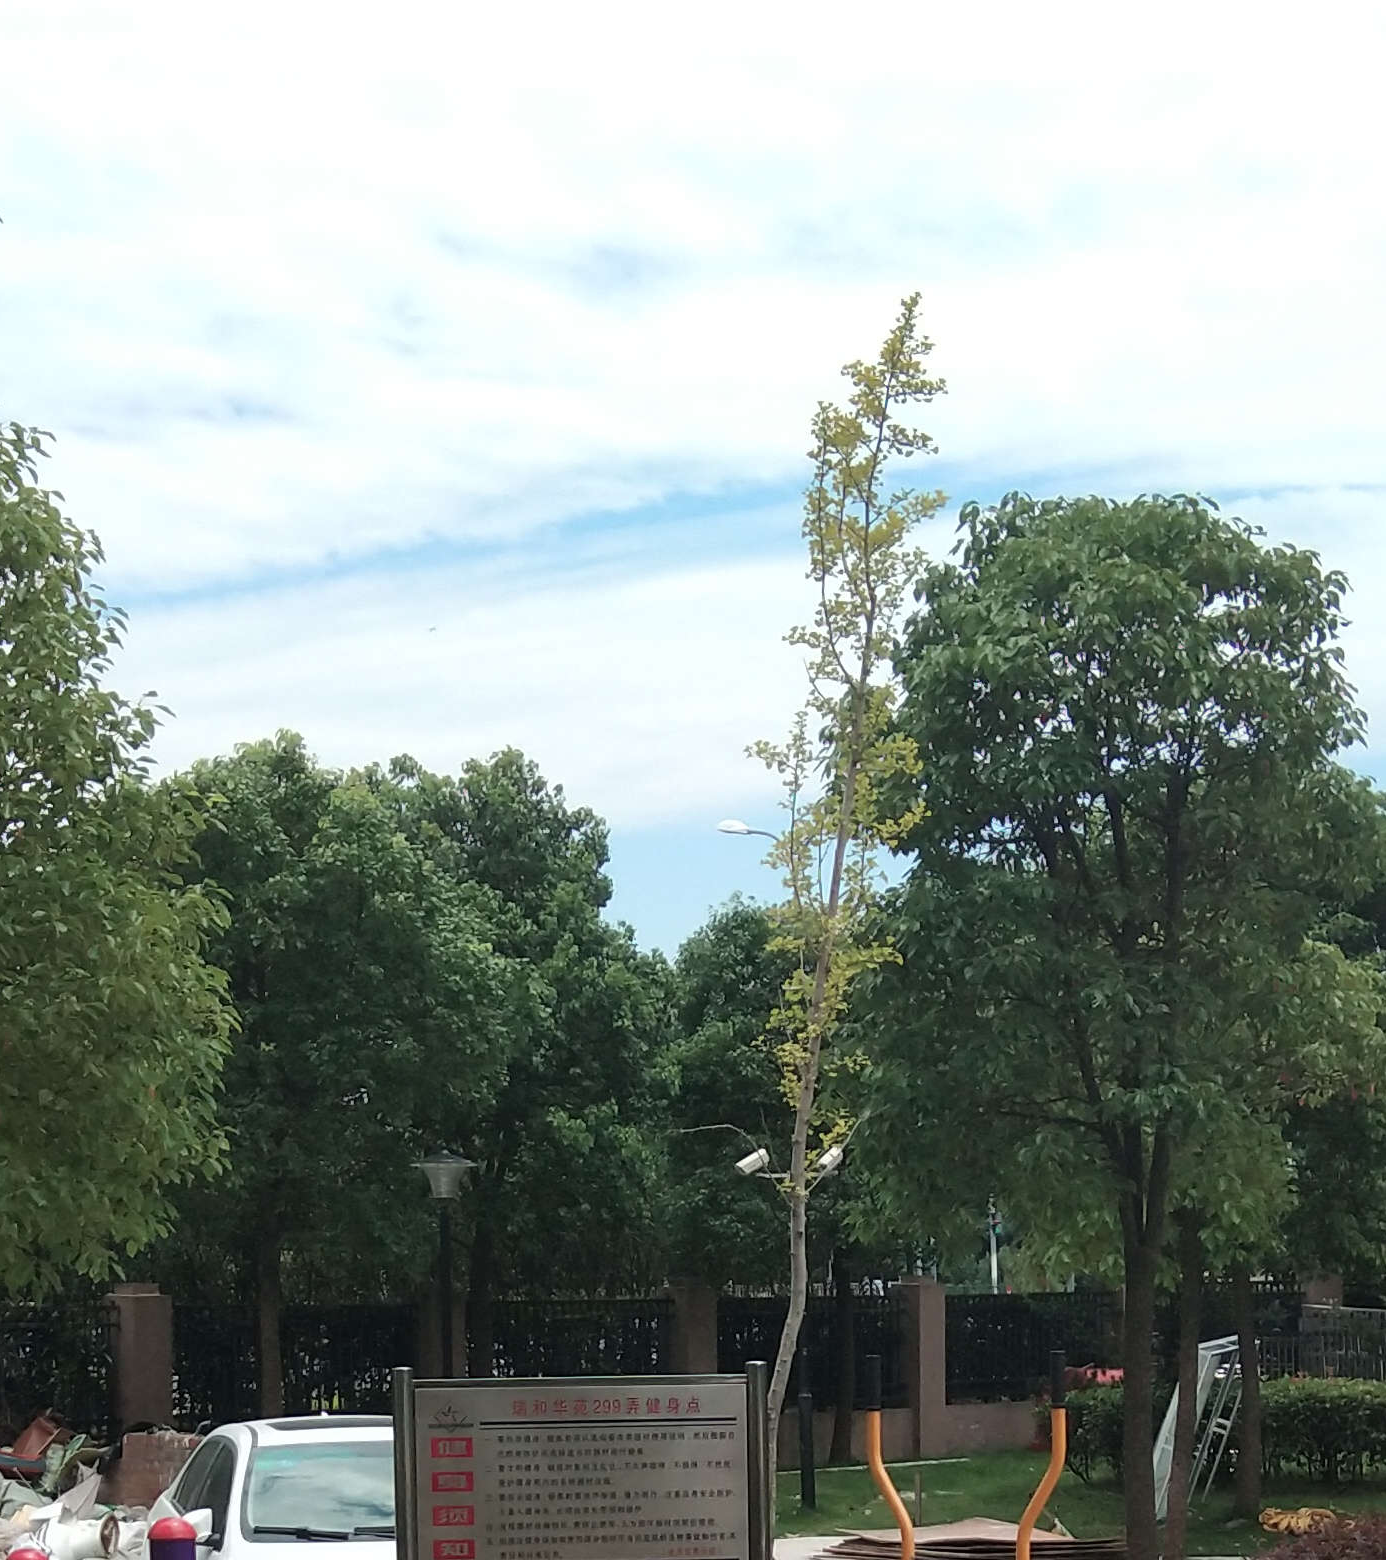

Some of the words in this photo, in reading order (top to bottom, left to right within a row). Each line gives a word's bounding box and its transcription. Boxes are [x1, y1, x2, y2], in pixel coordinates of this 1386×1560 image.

[512, 1397, 701, 1417] 瑞和华苑299弄健身点
